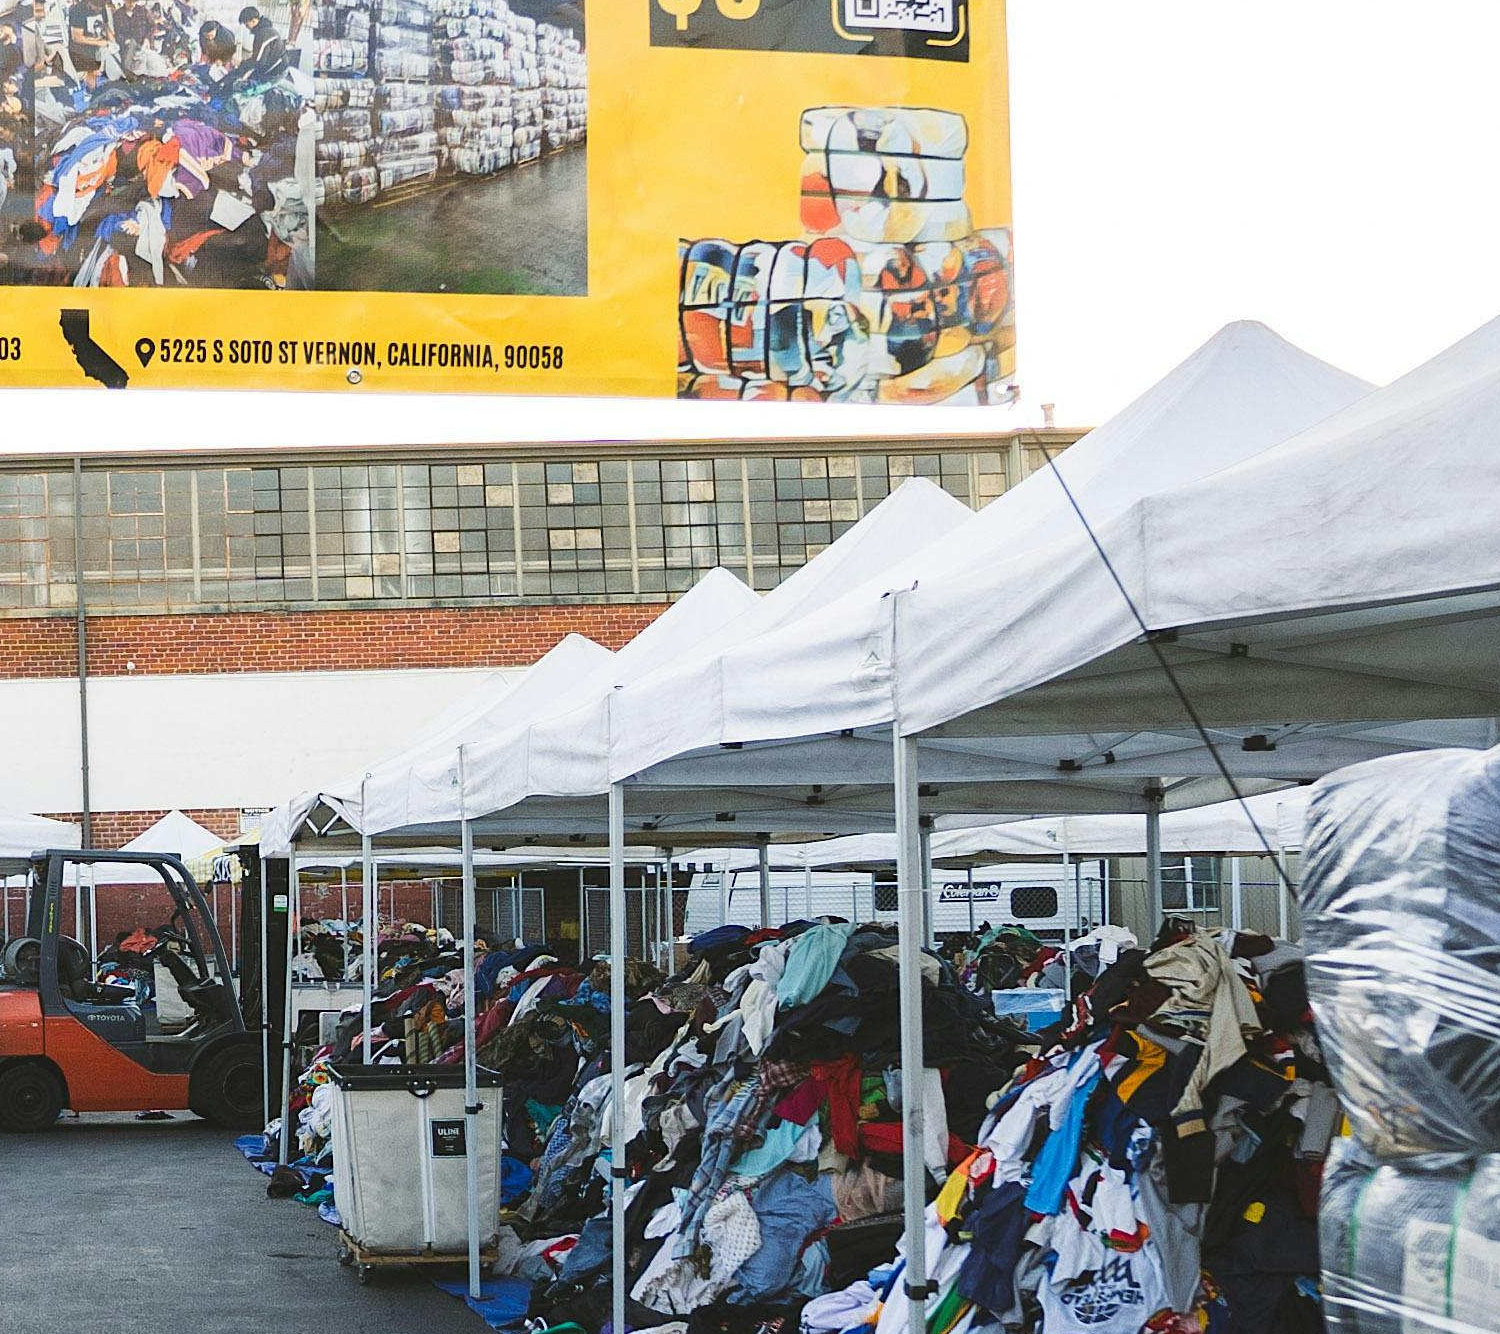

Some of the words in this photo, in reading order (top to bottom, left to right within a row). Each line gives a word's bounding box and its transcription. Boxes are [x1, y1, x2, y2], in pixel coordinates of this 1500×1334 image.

[160, 338, 207, 364] 5225
[213, 339, 223, 364] S
[229, 339, 273, 365] SOTO
[278, 340, 297, 365] ST
[303, 340, 381, 368] VERNON,
[387, 342, 499, 372] CALIFORNIA,
[504, 344, 563, 370] 90058
[96, 1014, 125, 1022] TOYOTA
